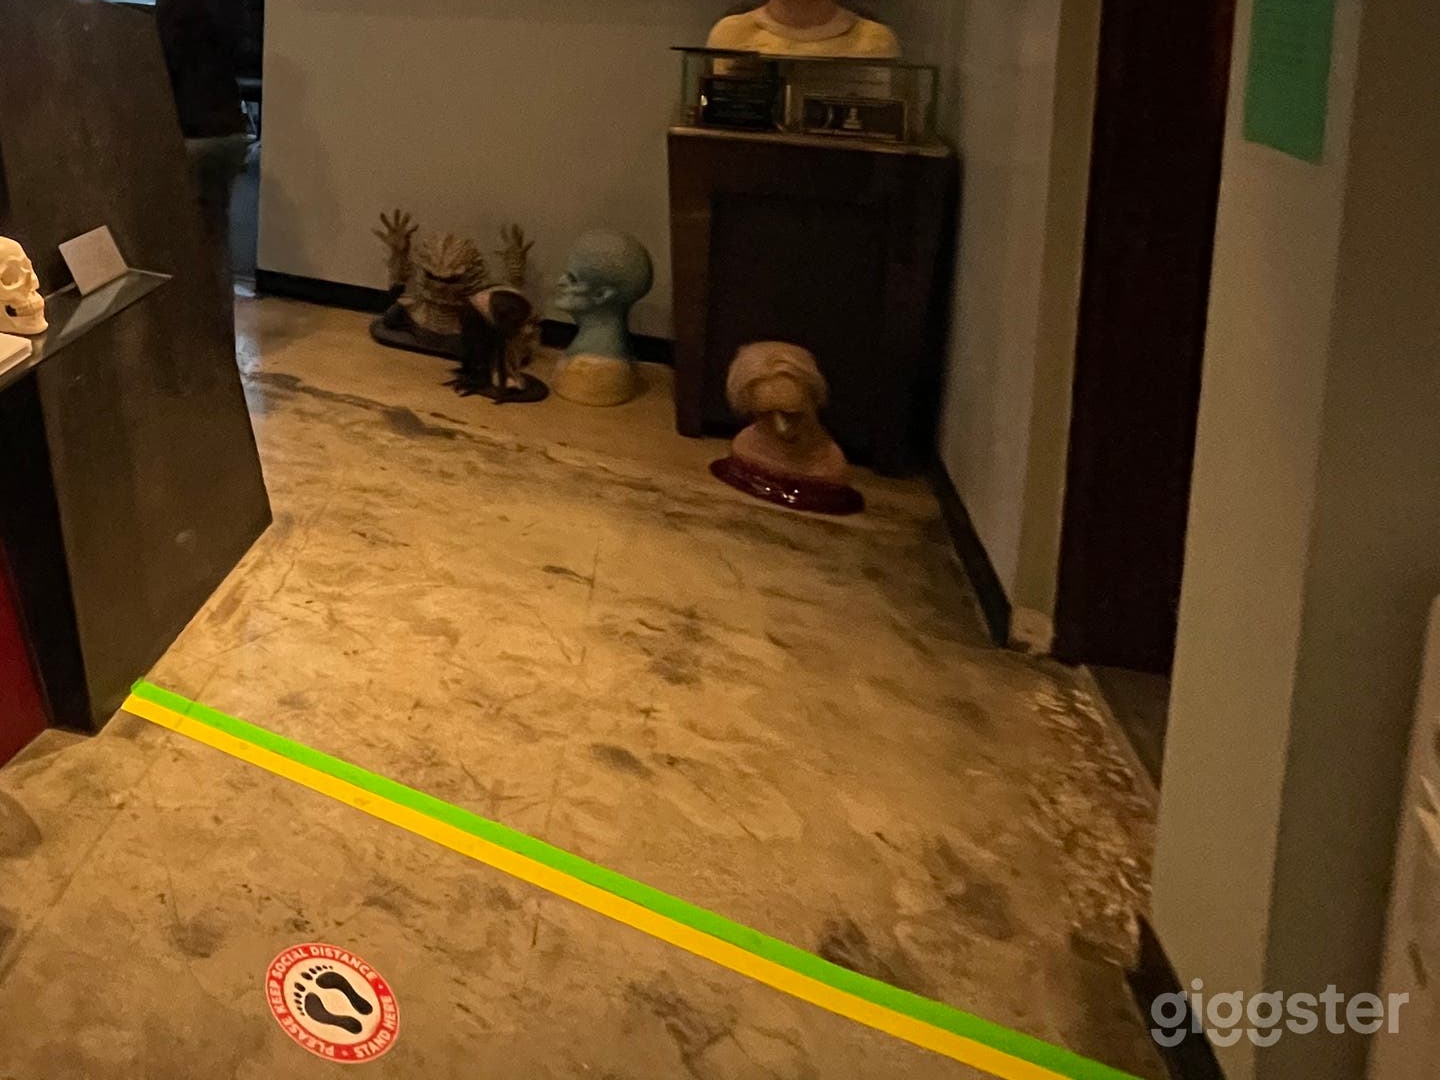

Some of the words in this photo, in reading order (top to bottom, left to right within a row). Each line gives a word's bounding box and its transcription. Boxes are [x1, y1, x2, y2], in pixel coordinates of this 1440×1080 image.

[271, 948, 308, 978] SOCIAL
[309, 946, 377, 982] DISTANCE
[269, 980, 286, 1014] KEEP
[280, 1017, 335, 1057] PLEASE
[353, 1029, 392, 1058] STAND
[380, 995, 398, 1030] HERE
